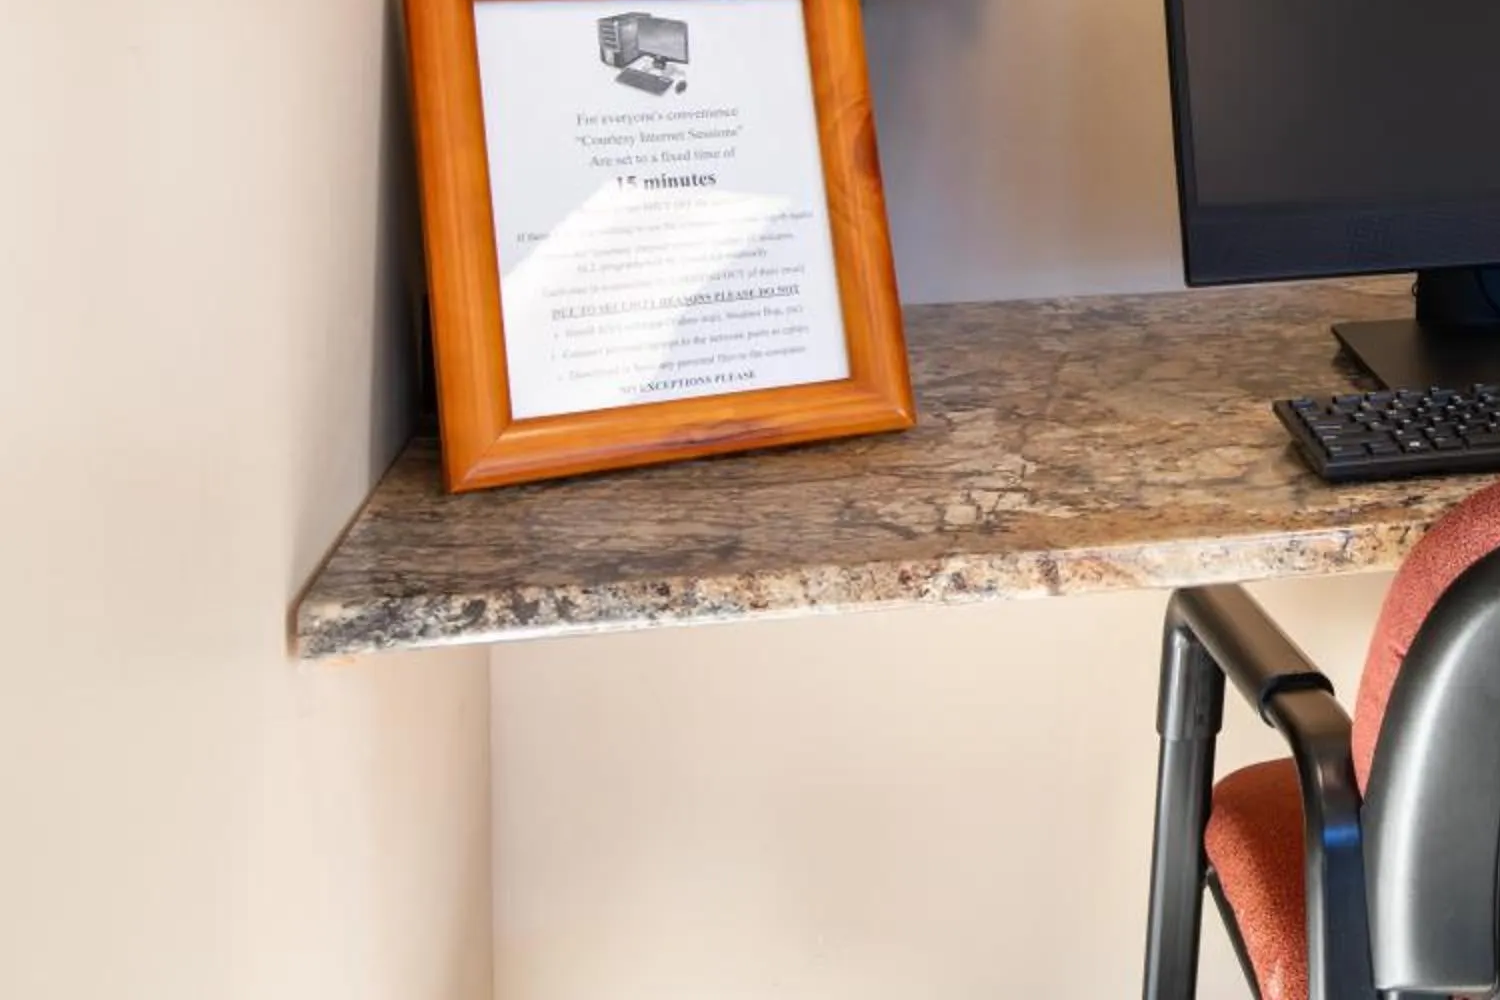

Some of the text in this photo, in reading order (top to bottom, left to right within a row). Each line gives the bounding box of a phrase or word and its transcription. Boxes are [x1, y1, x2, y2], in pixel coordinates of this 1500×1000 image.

[577, 105, 739, 126] For everyone's convenience
[640, 130, 685, 144] Internet
[591, 147, 736, 167] Are set to a fixed time of
[643, 172, 717, 190] minutes
[714, 290, 754, 302] PLEASE
[758, 286, 775, 298] DO
[777, 283, 800, 296] NOT
[639, 376, 712, 393] EXCEPTIONS
[714, 370, 755, 383] PLEASE
